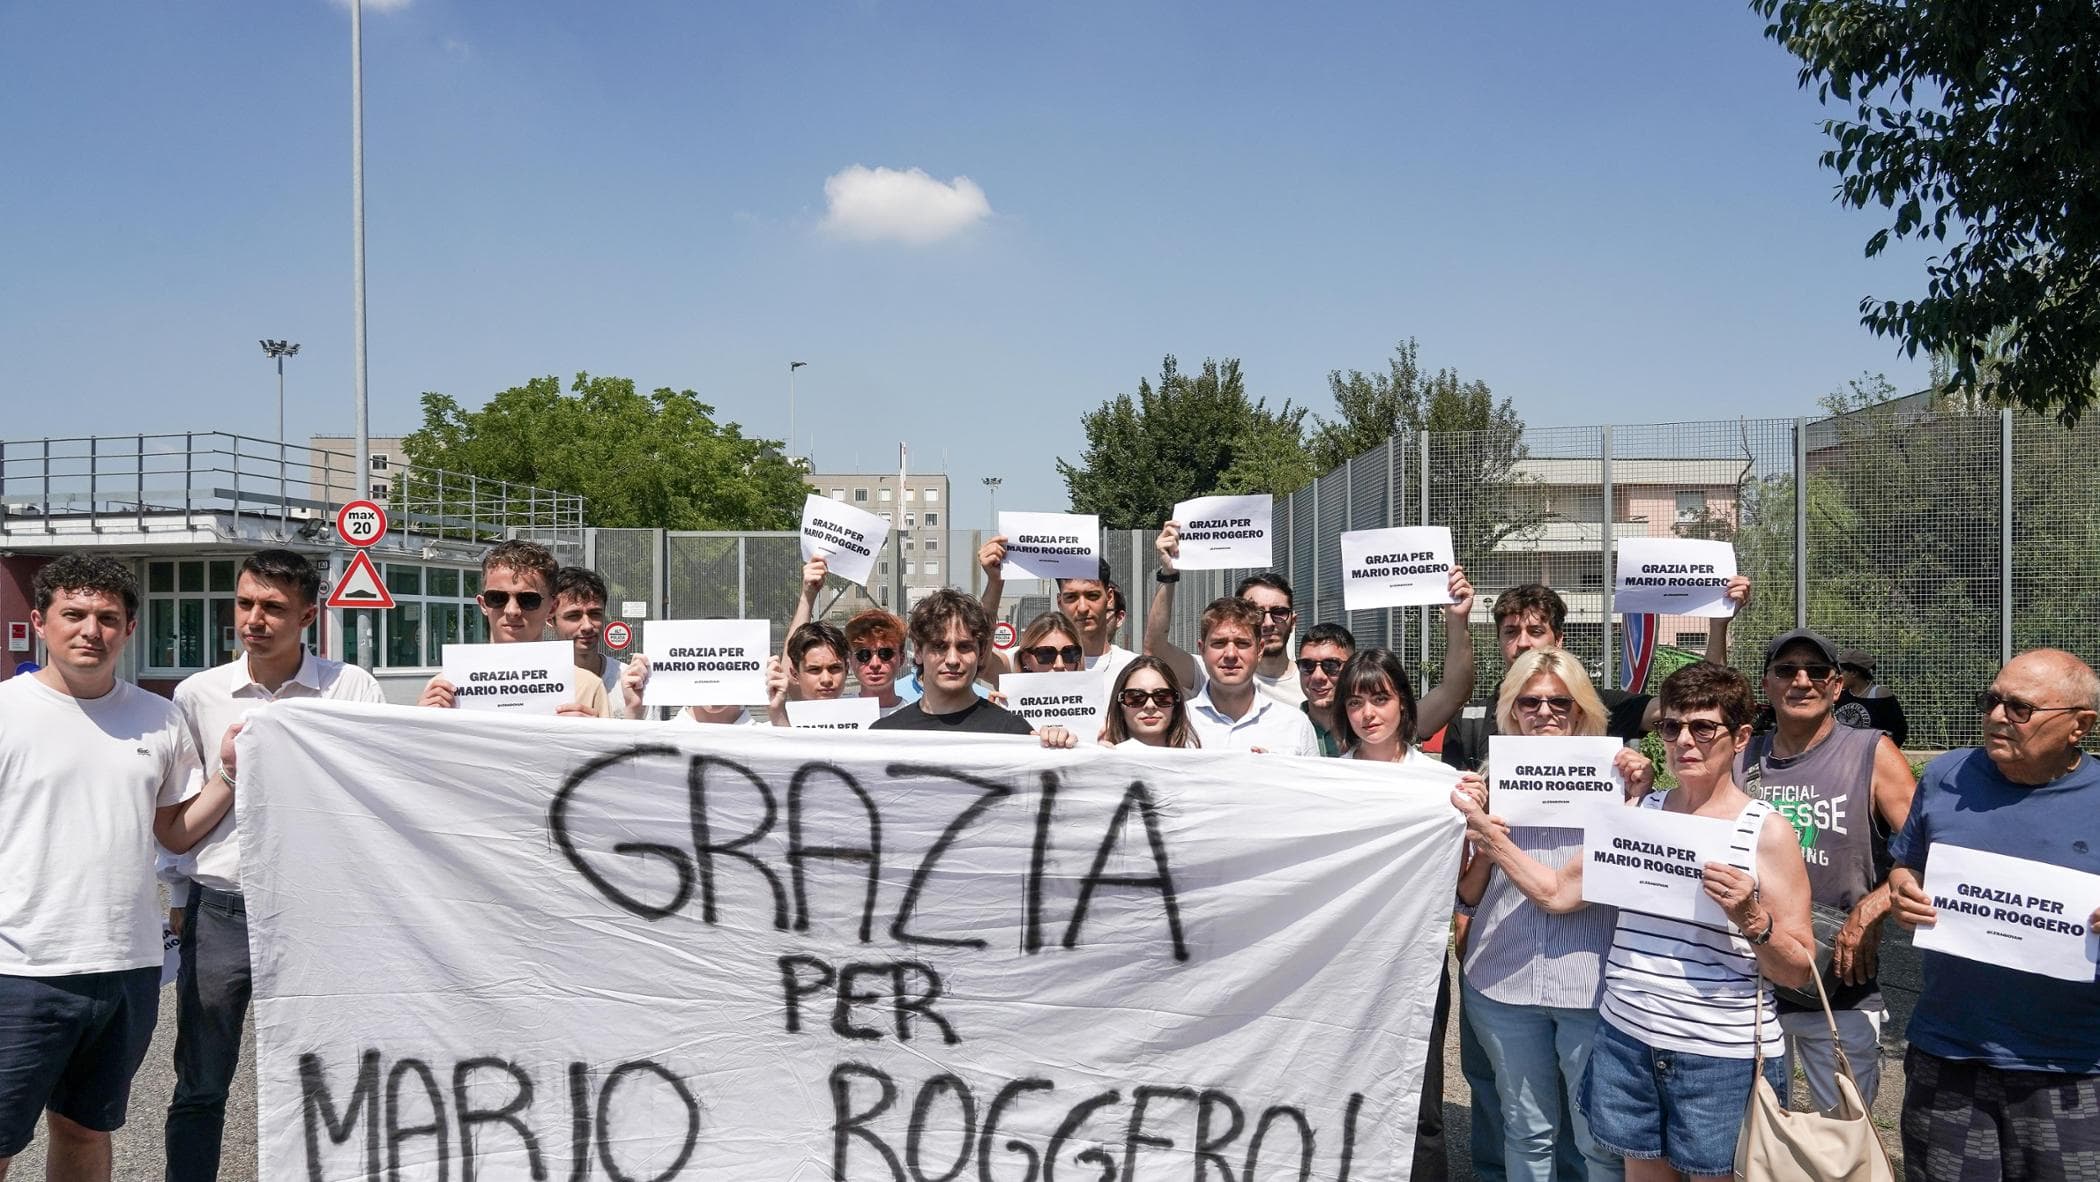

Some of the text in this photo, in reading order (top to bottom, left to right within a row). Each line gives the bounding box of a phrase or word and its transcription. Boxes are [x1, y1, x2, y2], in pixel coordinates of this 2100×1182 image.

[348, 512, 375, 520] max
[352, 522, 371, 534] 20
[812, 518, 864, 542] GRAZIA PER
[1190, 519, 1250, 529] GRAZIA PER
[1019, 535, 1079, 544] GRAZIA PER
[1213, 530, 1264, 539] ROGGERO
[804, 527, 824, 539] MARIO
[824, 533, 870, 556] ROGGERO
[1006, 545, 1091, 555] MARIO ROGGERO
[1366, 552, 1434, 564] GRAZIA PER
[1352, 564, 1449, 578] MARIO ROGGERO
[1642, 564, 1714, 574] GRAZIA PER
[1625, 577, 1666, 586] MARIO
[669, 647, 744, 657] GRAZIA PER
[653, 661, 760, 672] MARIO ROGGERO
[470, 670, 548, 681] GRAZIA PER
[454, 683, 564, 696] MARIO ROGGERO
[1020, 696, 1083, 706] GRAZIA PER
[1044, 707, 1096, 717] ROGGERO
[1516, 765, 1596, 776] GRAZIA PER
[1499, 780, 1613, 792] MARIO ROGGERO
[549, 744, 1189, 961] GRAZIA
[1612, 838, 1696, 862] GRAZIA PER
[1594, 851, 1703, 880] MARIO ROGGER
[1957, 883, 2064, 914] GRAZIA PER
[1933, 895, 2084, 936] MARIO ROGGERO
[778, 954, 960, 1044] PER
[299, 1047, 700, 1182] MARIO
